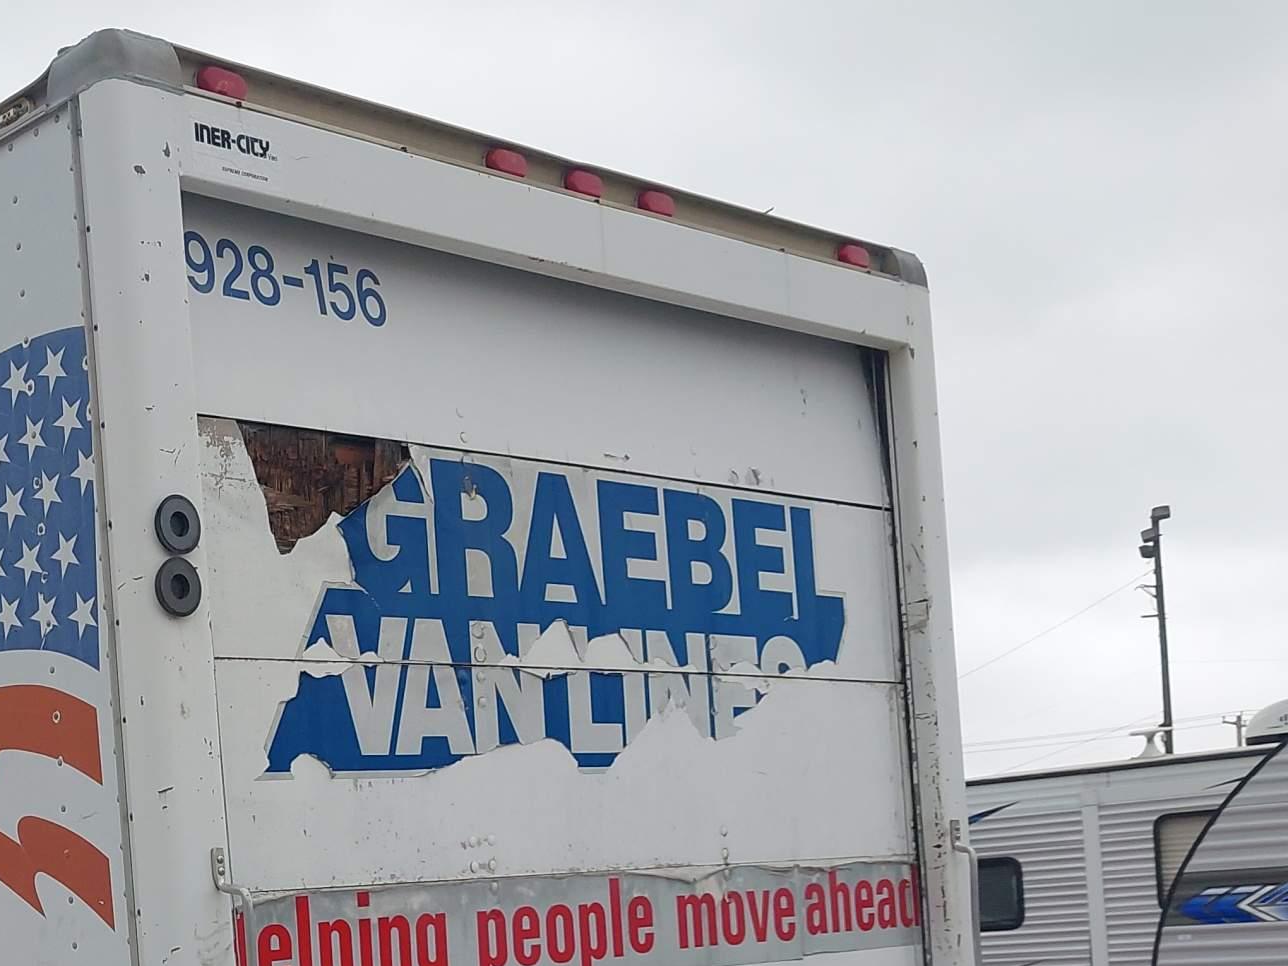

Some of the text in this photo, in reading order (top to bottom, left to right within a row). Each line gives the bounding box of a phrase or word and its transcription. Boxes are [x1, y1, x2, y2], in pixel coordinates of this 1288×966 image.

[194, 121, 270, 159] INER-CITY
[184, 230, 387, 327] 928-156
[338, 458, 846, 625] GRAEBEL
[325, 614, 546, 756] VAN
[676, 884, 796, 949] move
[805, 864, 921, 936] ahead
